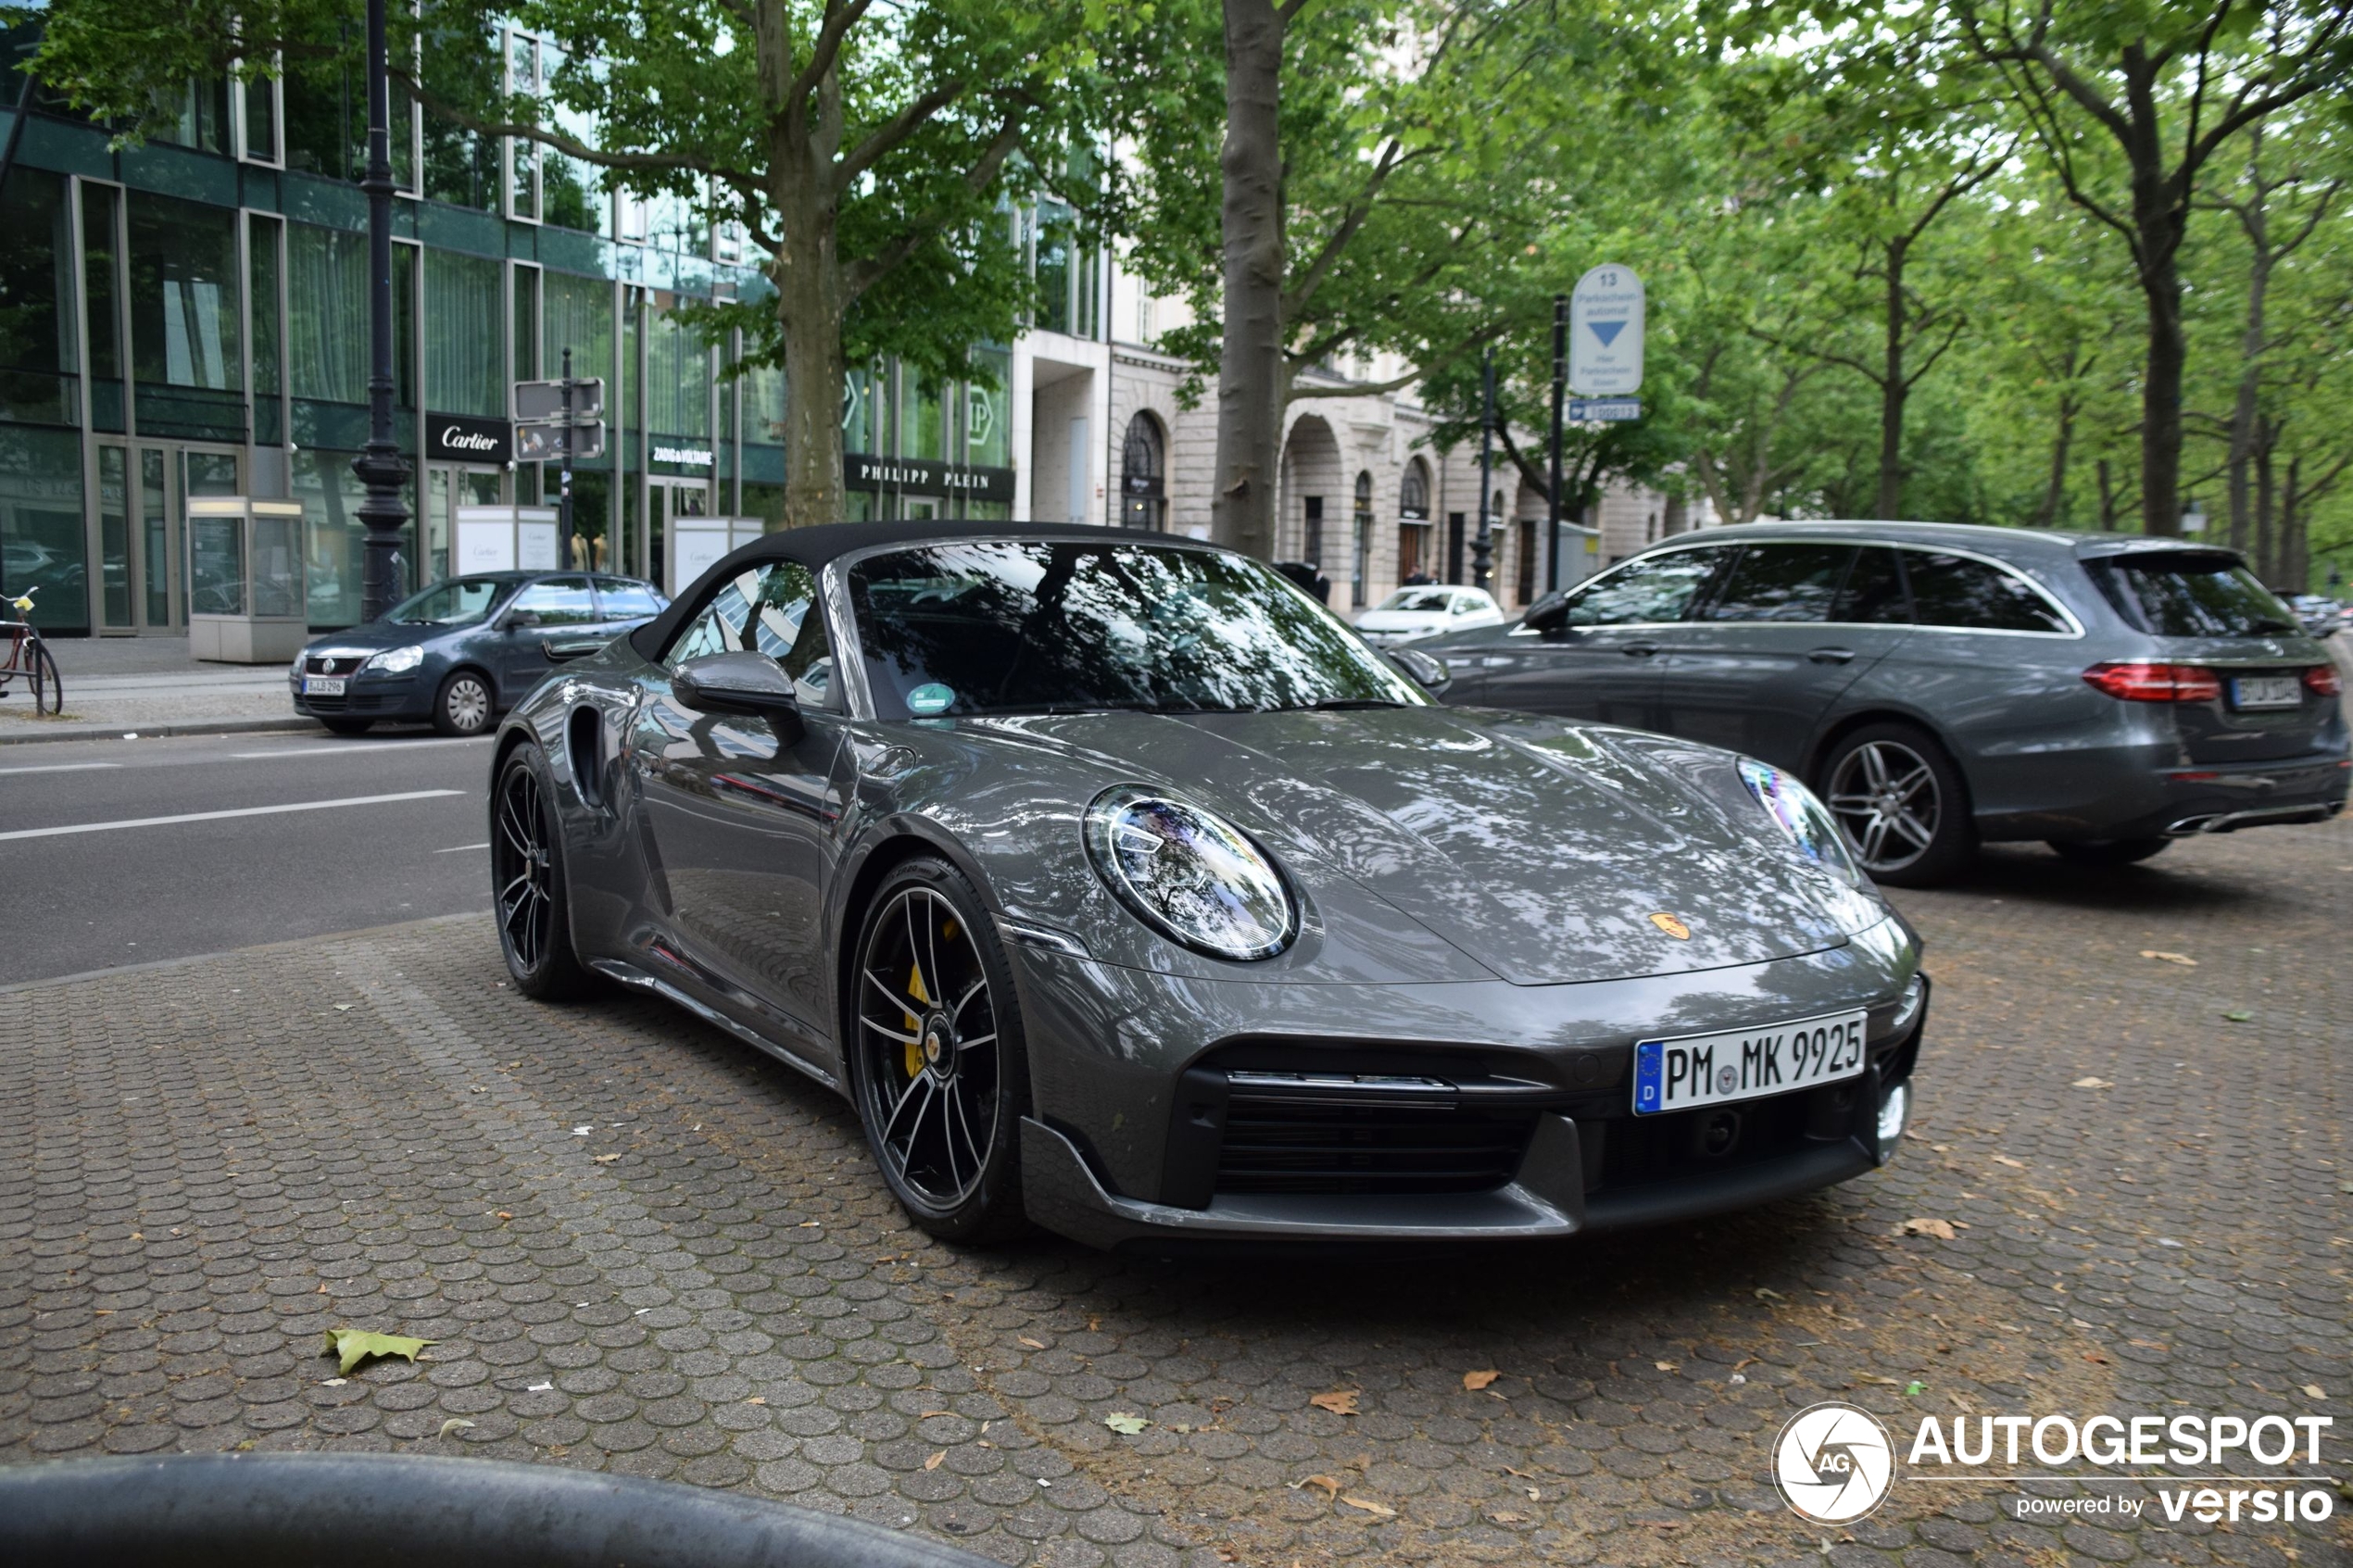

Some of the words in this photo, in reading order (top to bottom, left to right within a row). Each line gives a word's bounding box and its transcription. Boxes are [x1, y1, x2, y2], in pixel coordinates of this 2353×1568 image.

[1600, 272, 1617, 287] 13
[442, 425, 498, 451] Cartier
[861, 464, 929, 484] PHILIPP
[943, 471, 989, 489] PLEIN
[1667, 1045, 1713, 1100] PM
[1742, 1035, 1782, 1089] MK
[1793, 1021, 1862, 1082] 9925
[1643, 1085, 1655, 1100] D
